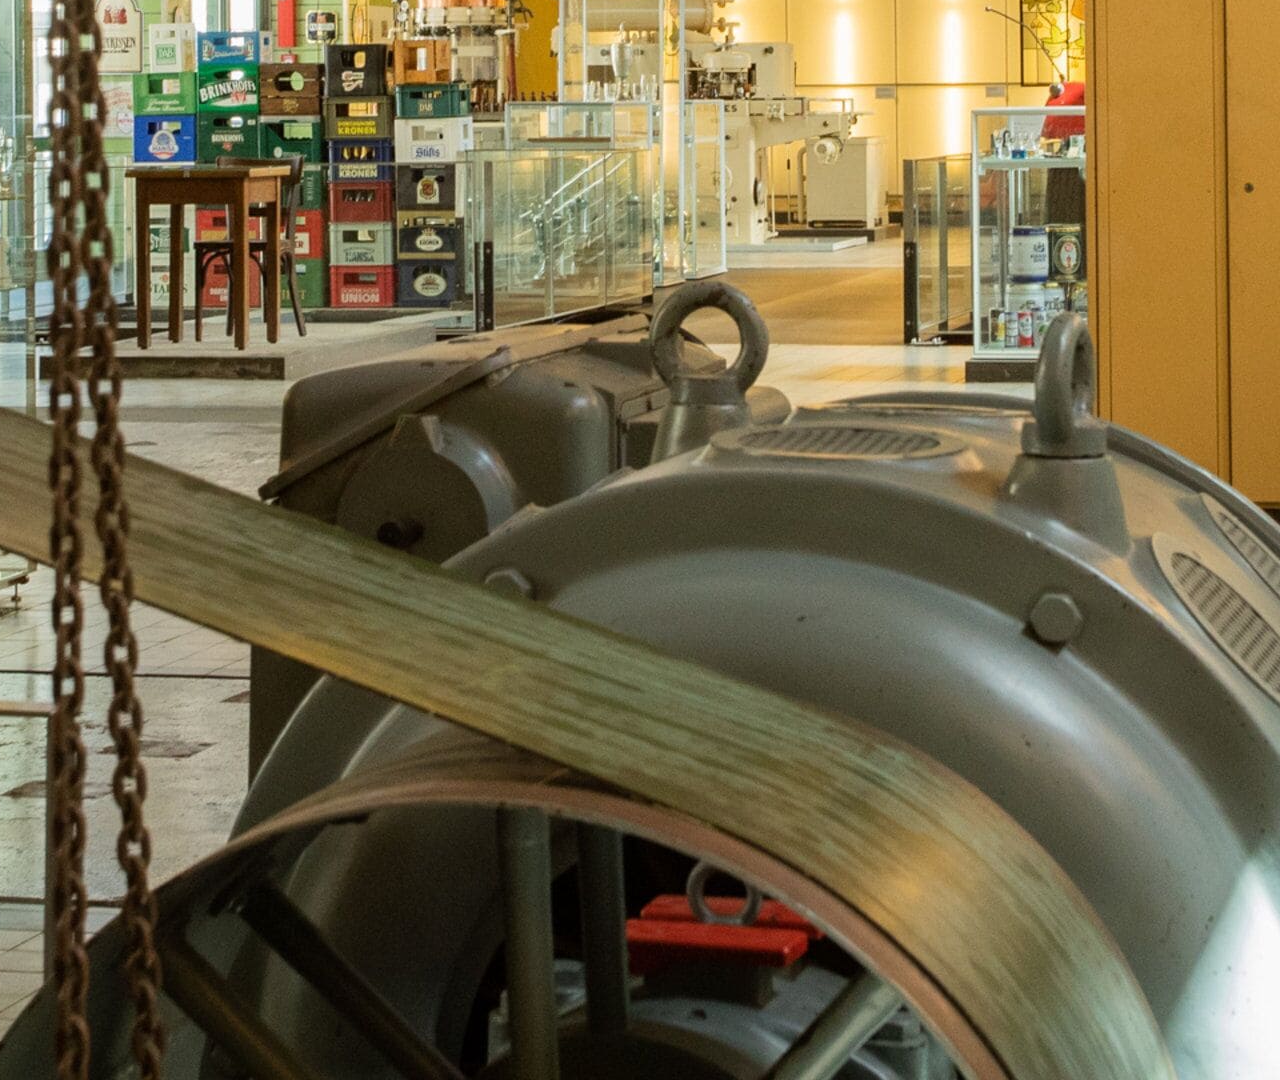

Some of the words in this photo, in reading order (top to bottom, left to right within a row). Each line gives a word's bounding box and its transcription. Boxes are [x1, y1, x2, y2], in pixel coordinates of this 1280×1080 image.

[337, 126, 377, 135] KRONEN
[339, 169, 378, 178] KRONEN
[340, 293, 380, 303] UNION
